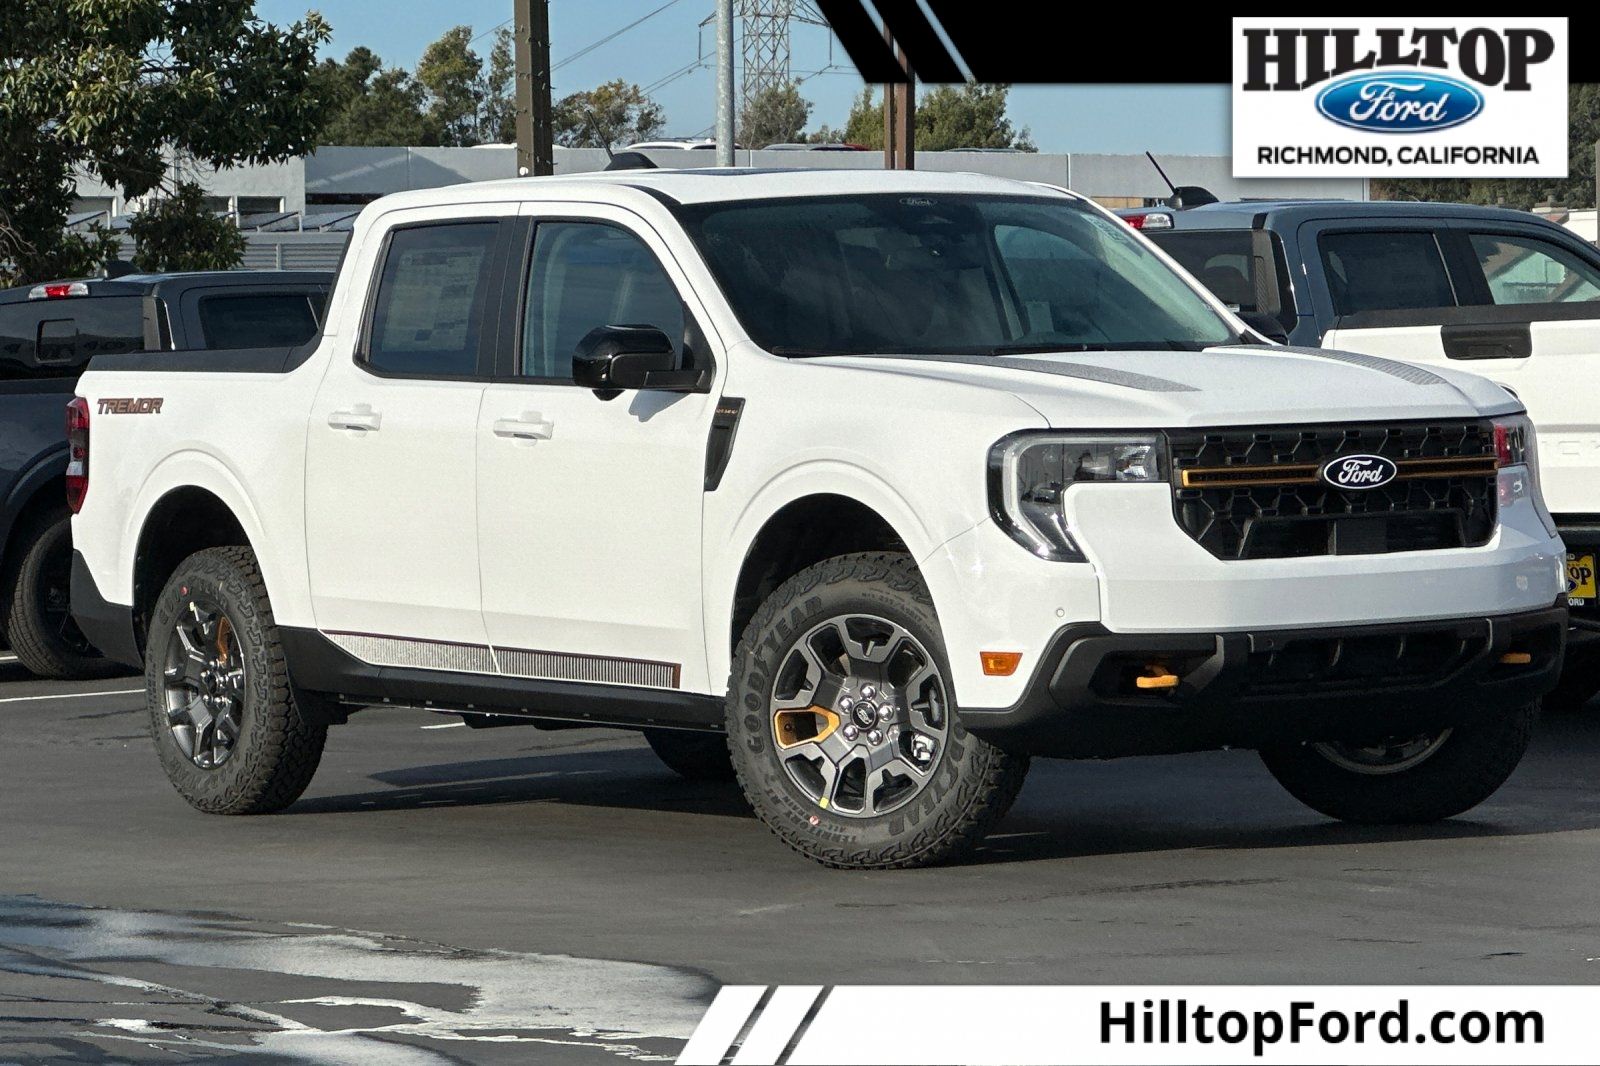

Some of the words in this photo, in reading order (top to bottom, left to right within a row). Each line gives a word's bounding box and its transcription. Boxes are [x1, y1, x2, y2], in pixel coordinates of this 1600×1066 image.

[97, 397, 164, 415] TREMOR
[1338, 459, 1384, 484] Ford
[1567, 597, 1585, 607] ORD
[743, 595, 823, 754] GOODYEAR
